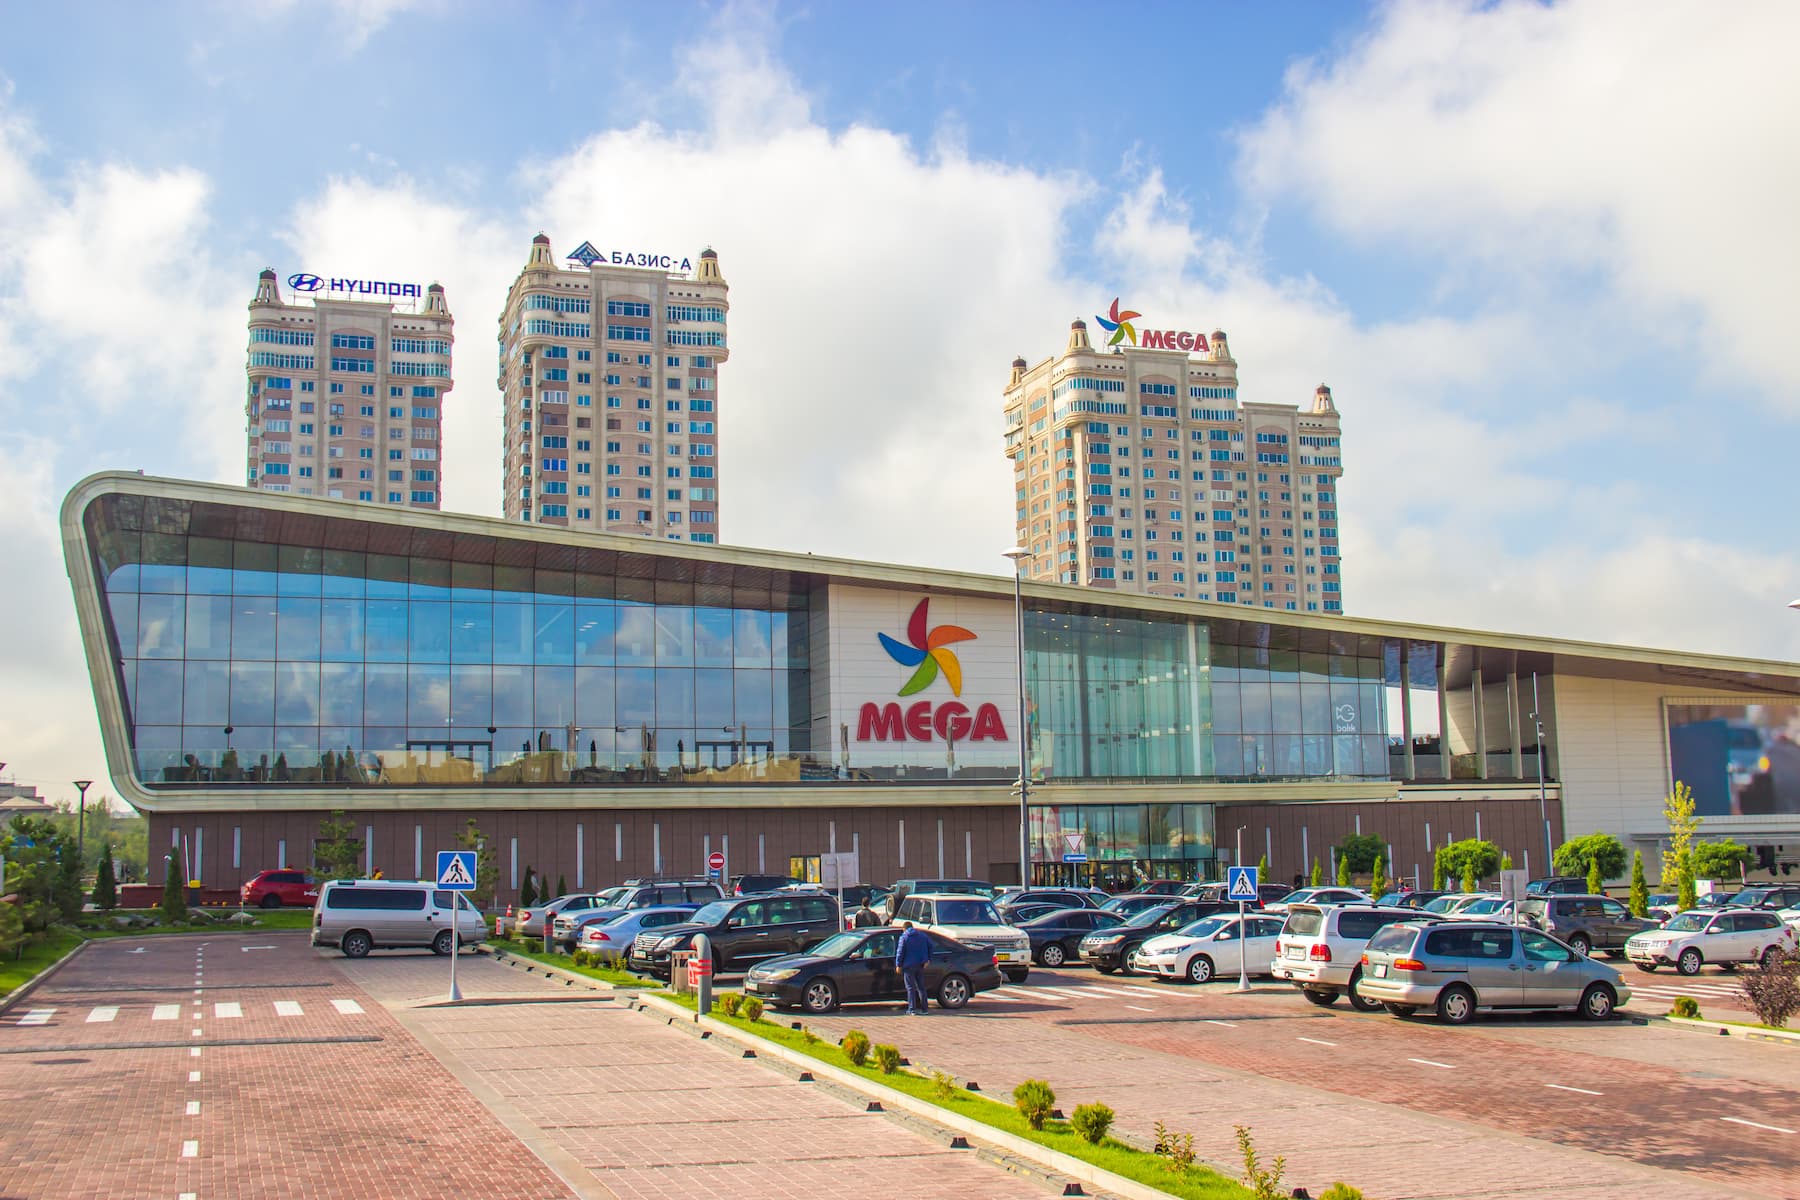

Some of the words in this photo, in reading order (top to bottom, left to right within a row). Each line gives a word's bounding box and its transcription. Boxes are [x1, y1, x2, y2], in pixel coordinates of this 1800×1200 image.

[612, 251, 692, 271] БАЗИС-А
[330, 278, 421, 298] HYUNDAI
[1141, 329, 1210, 352] MEGA
[856, 701, 1009, 742] MEGA
